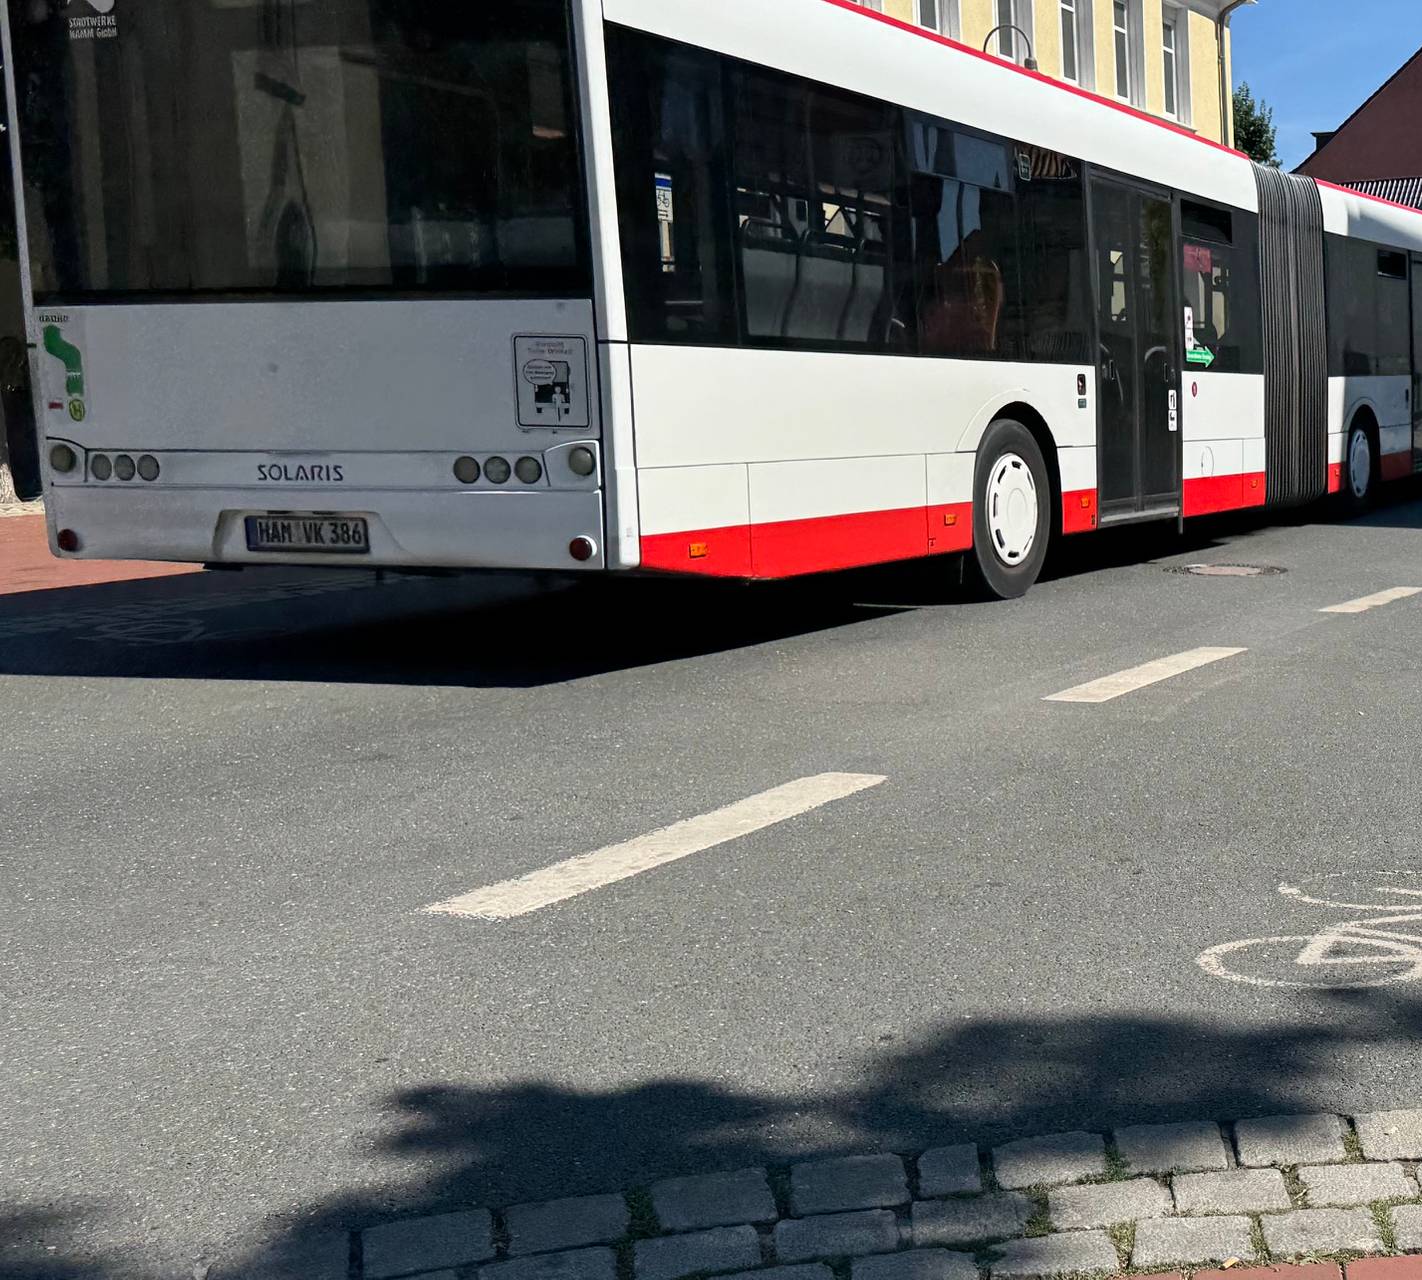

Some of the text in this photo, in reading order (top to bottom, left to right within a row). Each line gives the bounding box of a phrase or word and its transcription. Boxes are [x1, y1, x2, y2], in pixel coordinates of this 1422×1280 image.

[257, 464, 343, 481] SOLARIS
[258, 521, 363, 545] HAM VK 386
